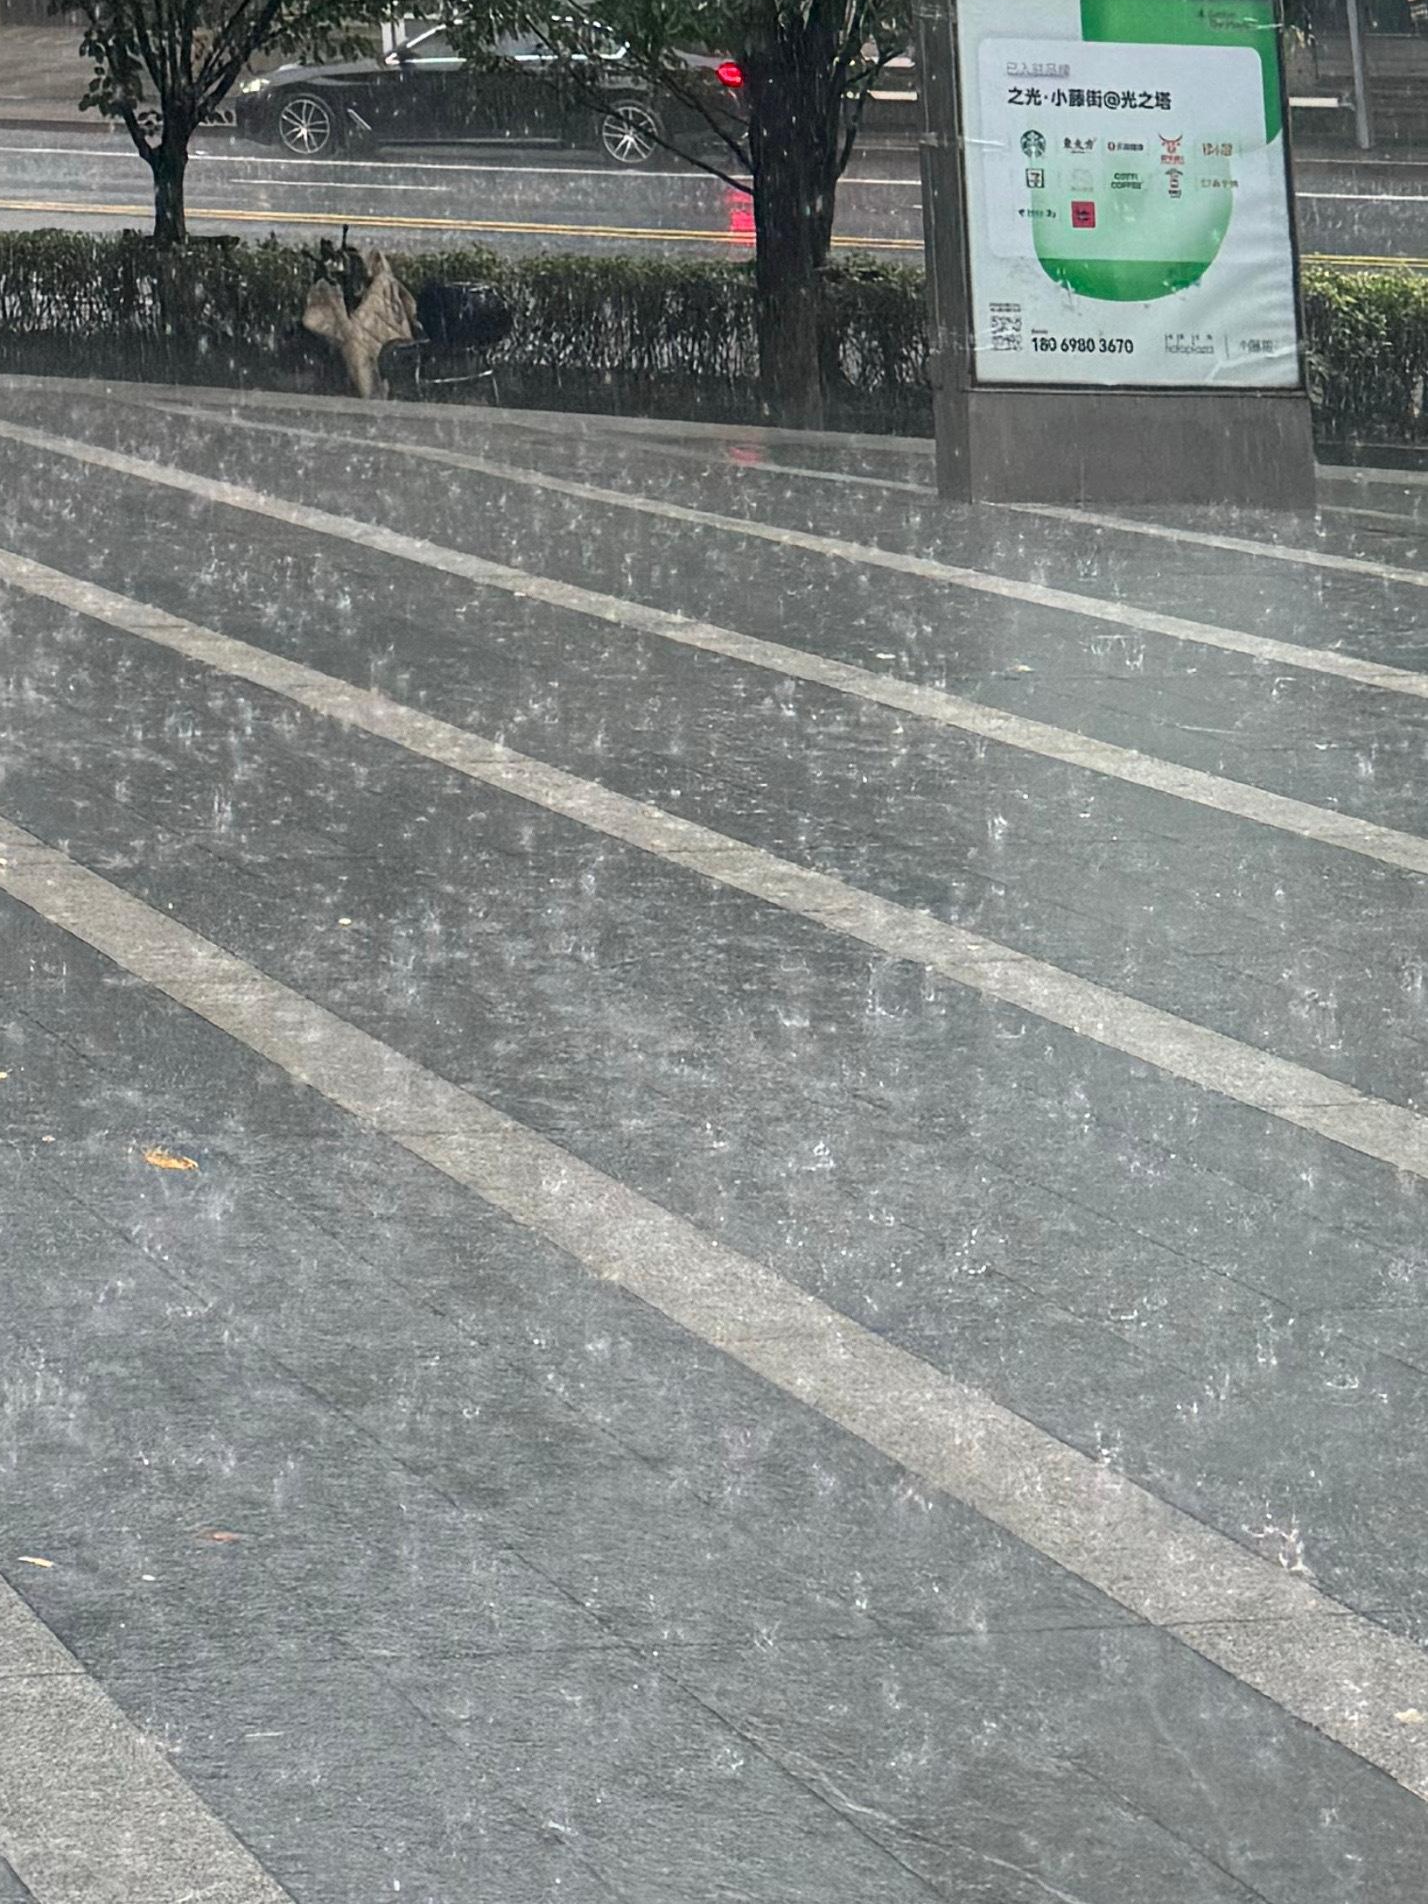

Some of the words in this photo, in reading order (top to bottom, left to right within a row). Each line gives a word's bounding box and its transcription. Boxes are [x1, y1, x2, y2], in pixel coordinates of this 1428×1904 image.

[1031, 337, 1057, 352] 180
[1060, 337, 1095, 353] 6980
[1098, 338, 1134, 354] 3670
